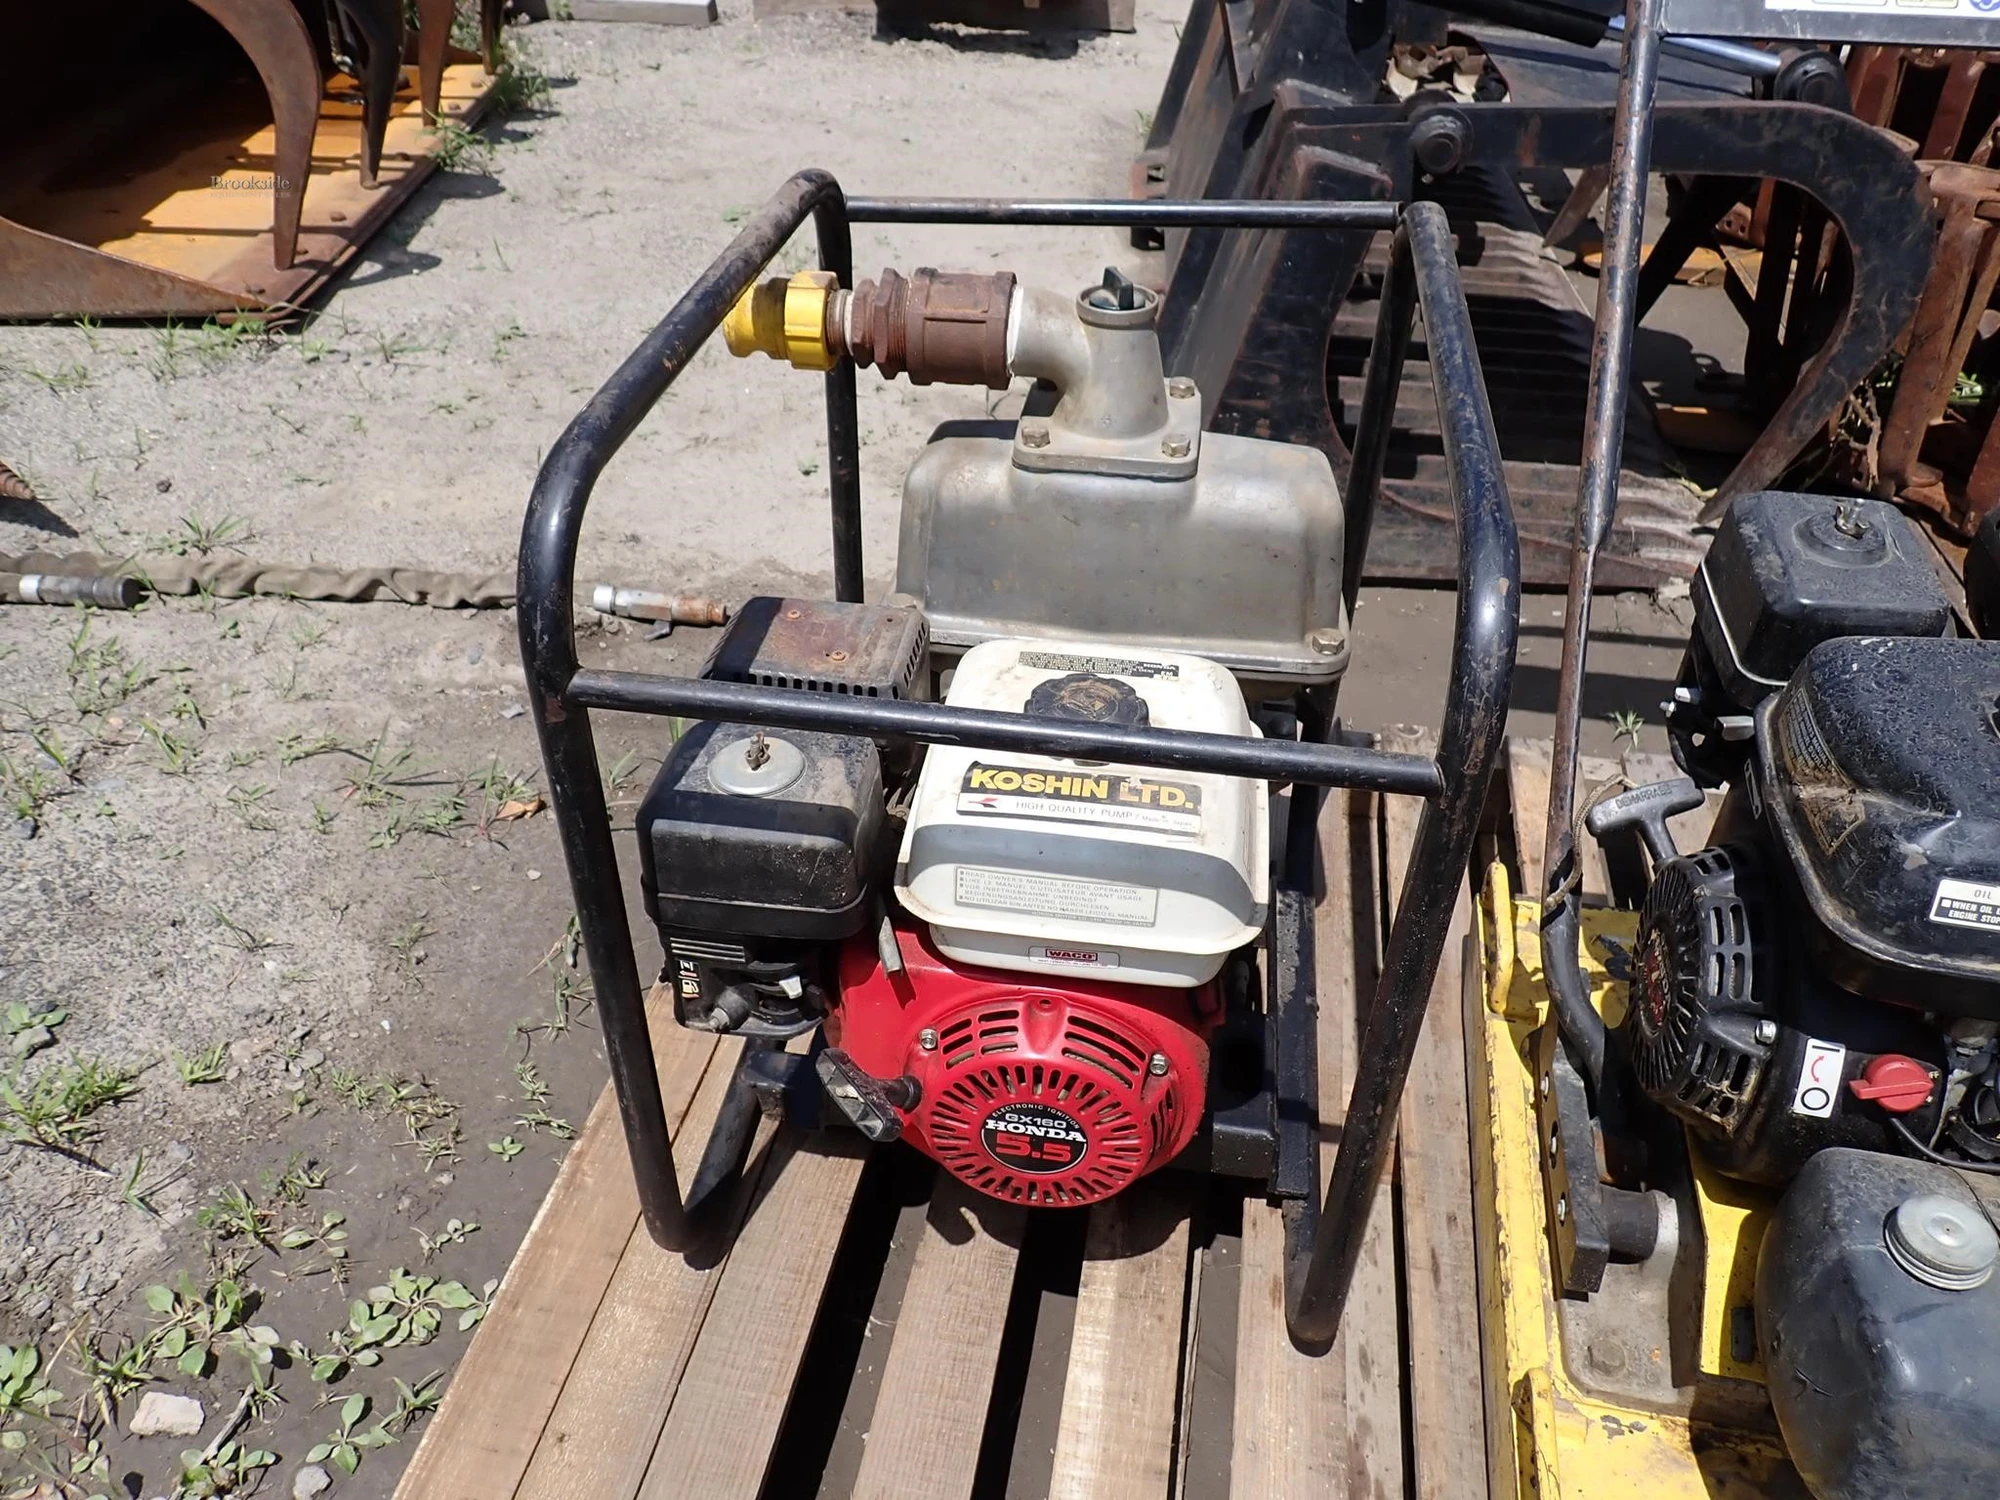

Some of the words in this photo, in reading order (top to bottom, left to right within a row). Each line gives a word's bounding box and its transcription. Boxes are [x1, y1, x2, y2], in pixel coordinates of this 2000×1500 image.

[970, 768, 1109, 799] KOSHIN
[1119, 781, 1194, 809] LTD.
[1016, 800, 1045, 811] HIGH
[1048, 803, 1096, 817] QUALITY
[1101, 808, 1133, 819] PUMP
[965, 870, 986, 879] READ
[987, 873, 1023, 883] OWNER'S
[1026, 878, 1058, 887] MANUAL
[1061, 882, 1092, 891] BEFORE
[1093, 885, 1138, 895] OPERATION
[995, 881, 1026, 890] MANUEL
[1089, 891, 1113, 899] AVANT
[1117, 894, 1142, 902] USAGE
[1053, 893, 1097, 903] UNBEDINGT
[1973, 889, 1992, 900] OIL
[976, 897, 1008, 906] UTILIZAR
[1022, 902, 1046, 910] ANTES
[1118, 913, 1149, 921] MANUAL
[1059, 900, 1110, 911] DURCHLESEN
[1948, 909, 1978, 921] ENGINE
[1952, 900, 1978, 911] WHEN
[1979, 905, 1993, 914] OIL
[1049, 950, 1094, 960] WACO
[992, 1103, 1044, 1117] ELECTRONIC
[1047, 1107, 1080, 1129] IGNITION
[1005, 1112, 1067, 1129] GX160
[985, 1119, 1087, 1142] HONDA
[996, 1132, 1071, 1162] 5.5
